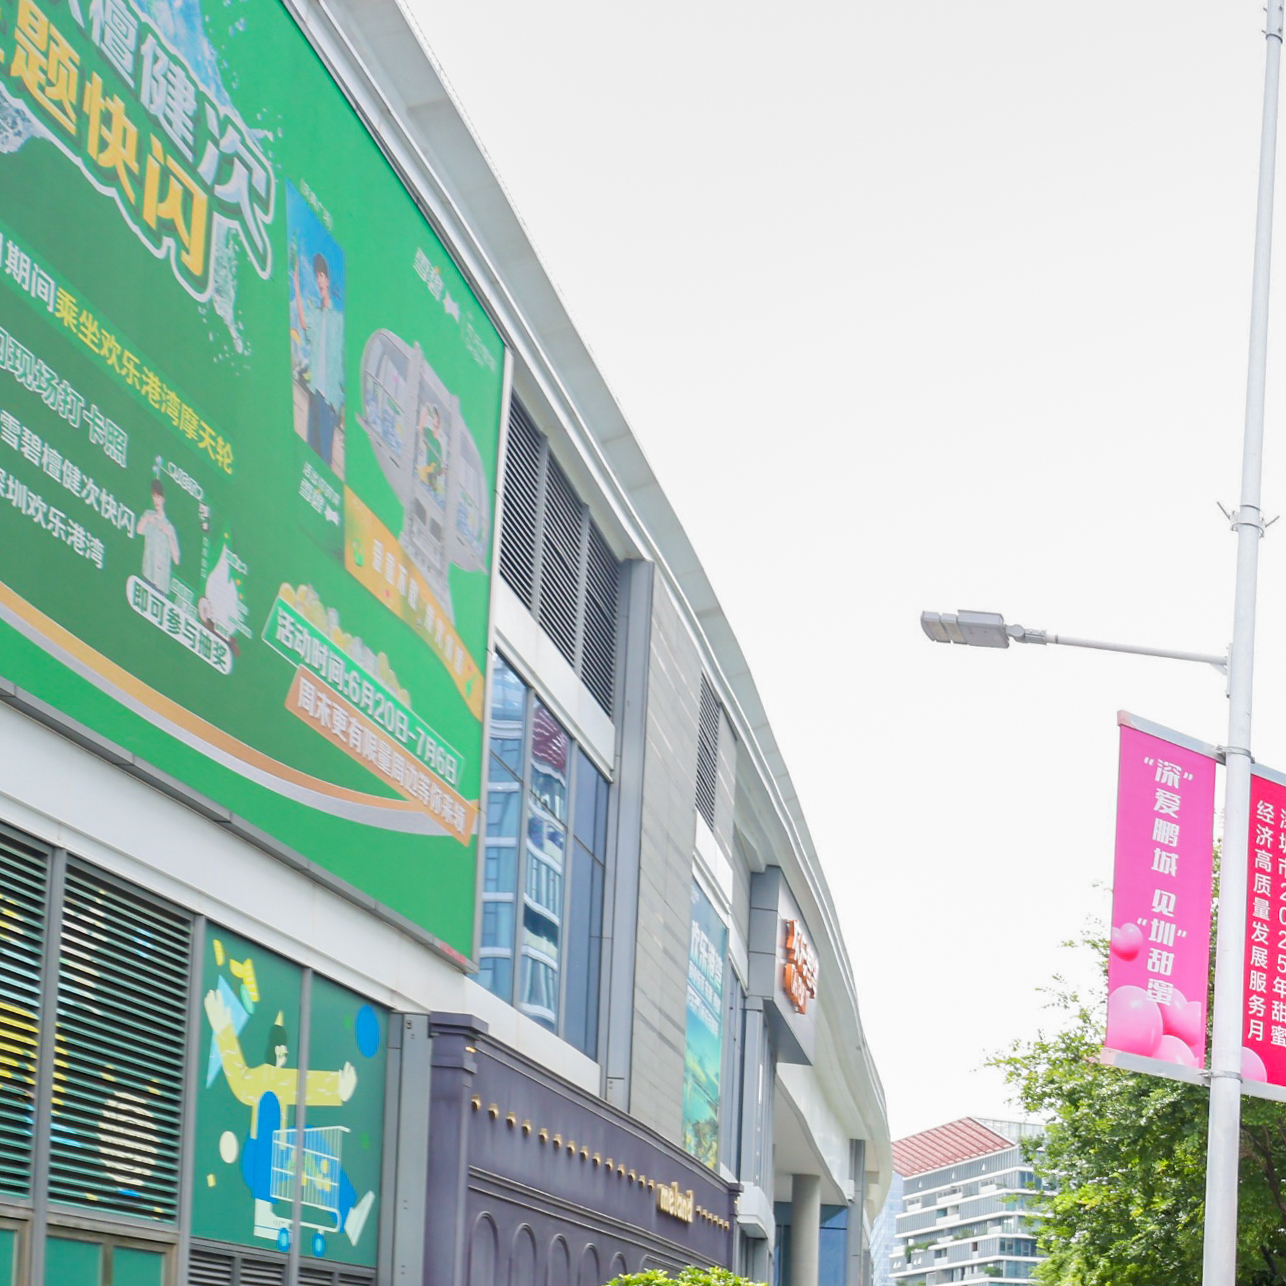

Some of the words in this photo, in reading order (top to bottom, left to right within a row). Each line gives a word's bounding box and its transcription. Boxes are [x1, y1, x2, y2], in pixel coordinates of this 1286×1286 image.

[0, 0, 208, 276] 题快闪
[0, 233, 235, 475] 期间乘坐欢乐港湾摩天轮
[132, 580, 228, 673] 即可参与抽奖
[1247, 799, 1275, 1042] 经济高质量发展服务月
